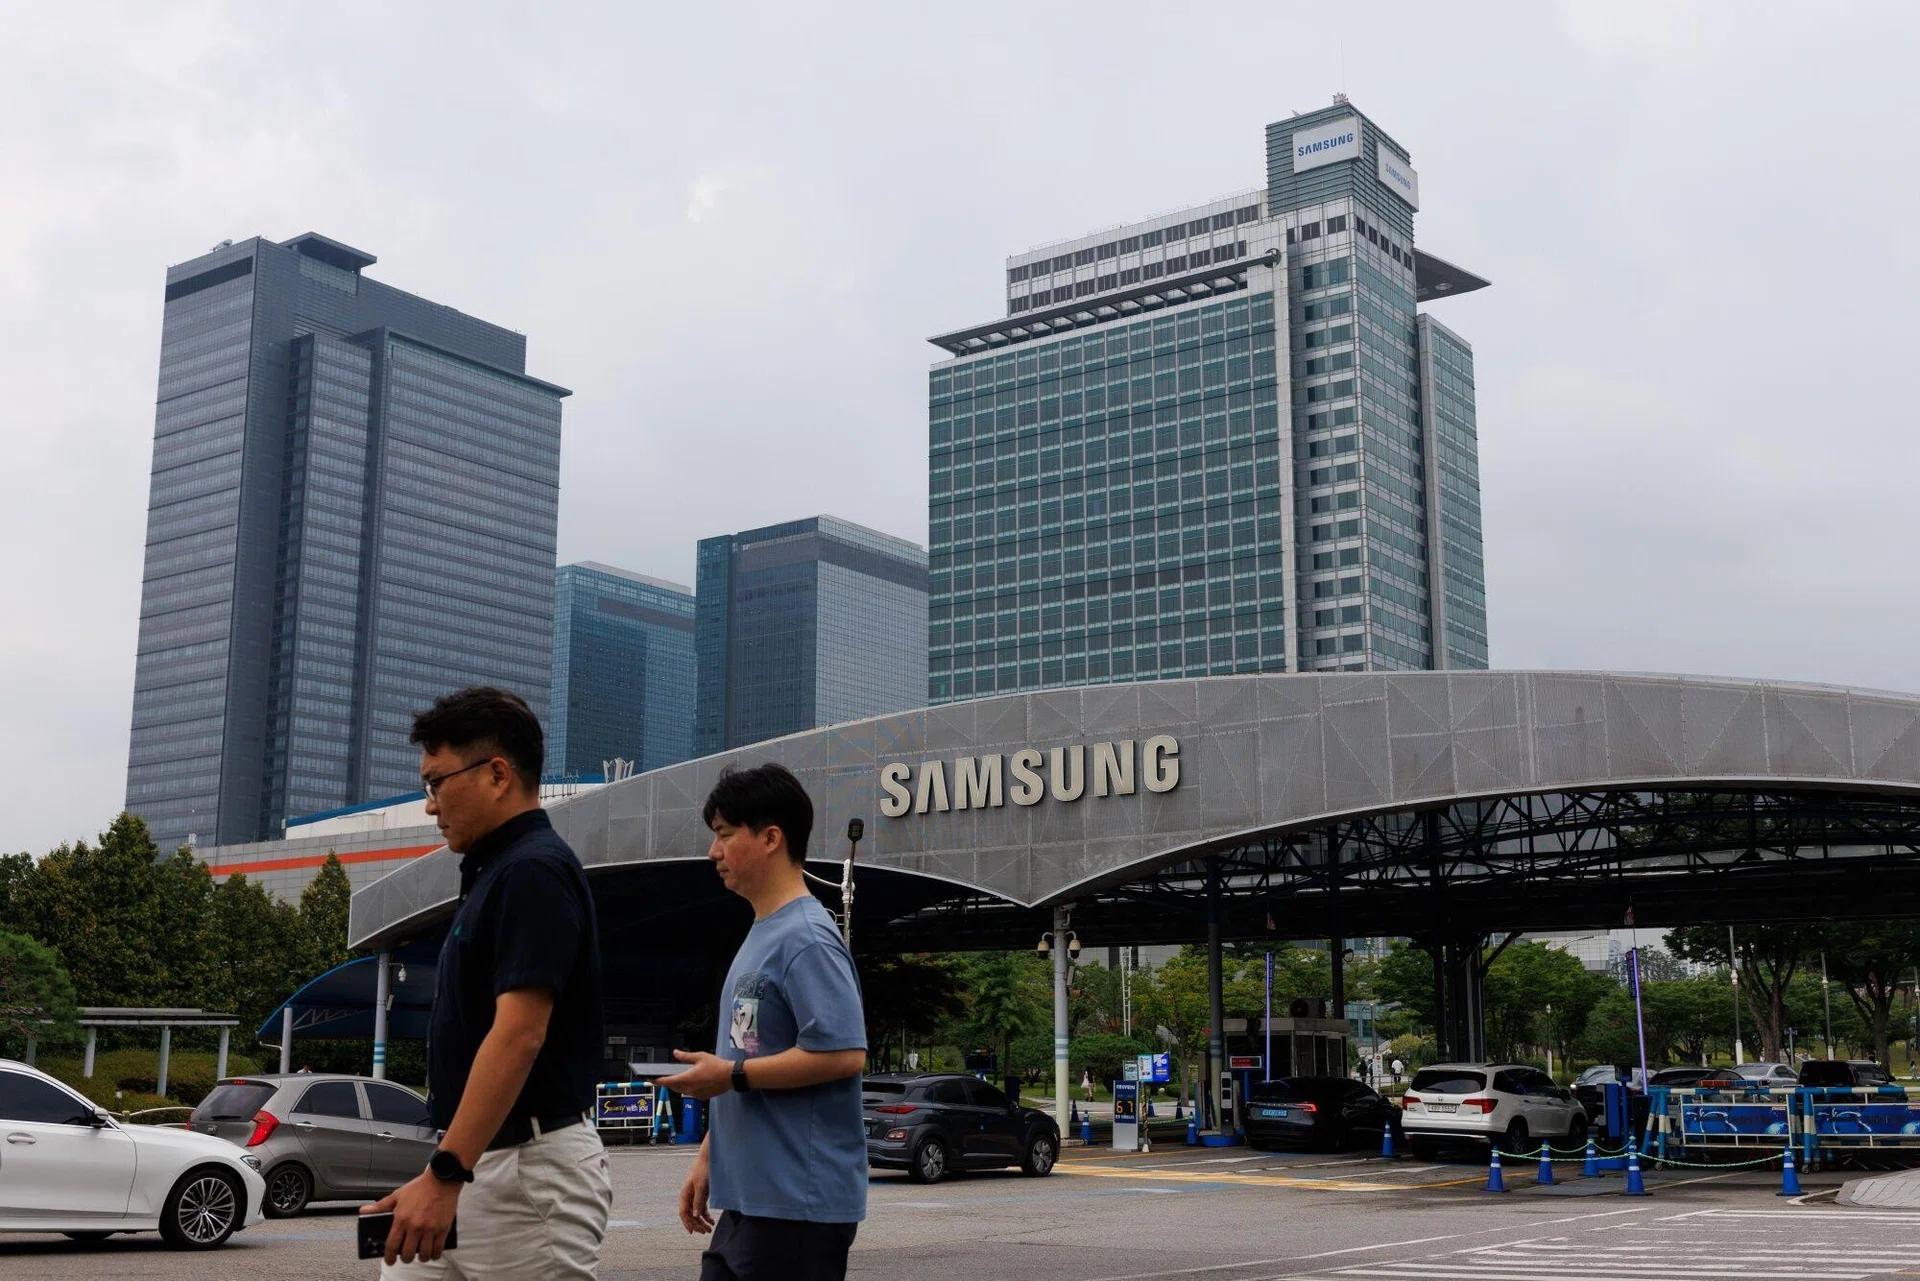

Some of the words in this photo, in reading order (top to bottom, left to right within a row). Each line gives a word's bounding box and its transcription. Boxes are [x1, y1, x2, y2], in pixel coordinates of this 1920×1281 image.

[1298, 133, 1353, 156] SAMSUNG
[1386, 163, 1411, 190] SAMSUNG
[880, 734, 1179, 817] SAMSUNG
